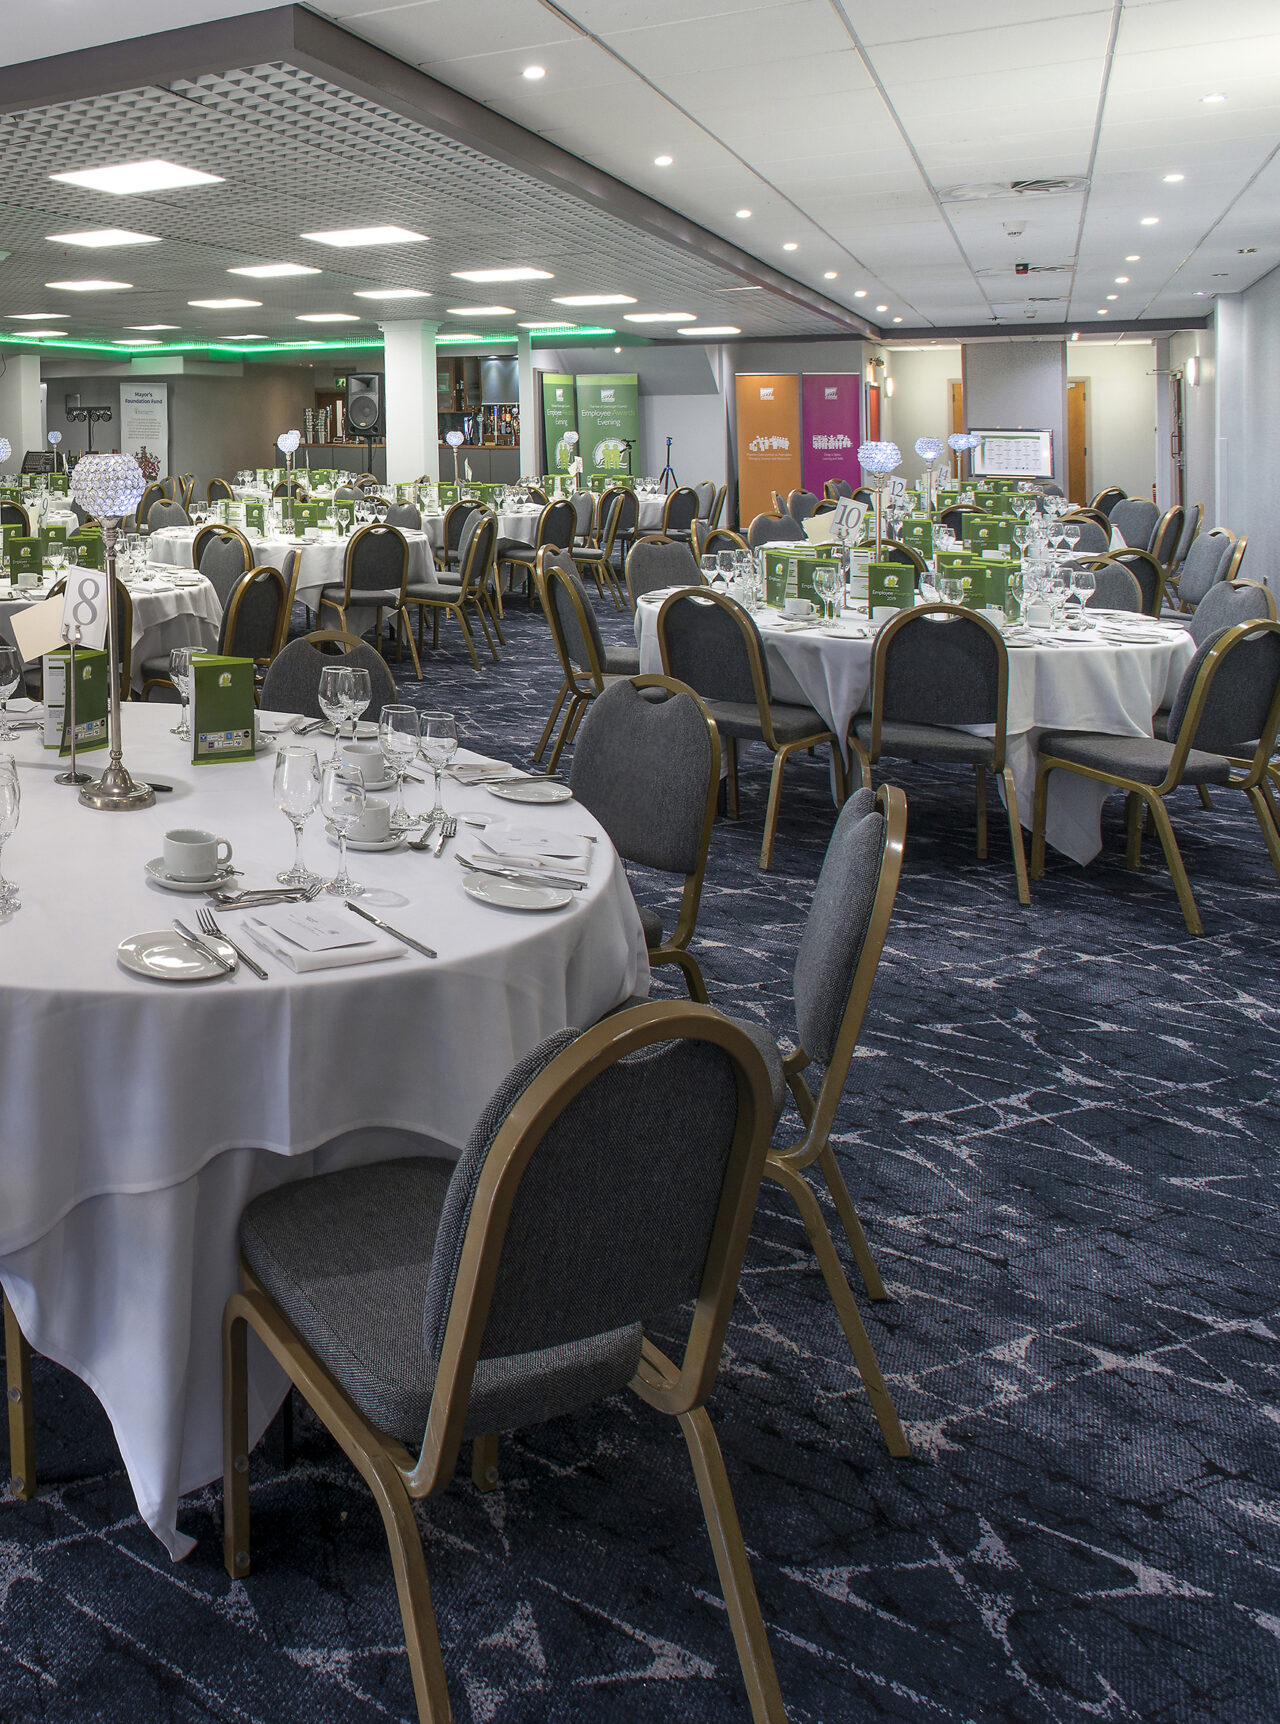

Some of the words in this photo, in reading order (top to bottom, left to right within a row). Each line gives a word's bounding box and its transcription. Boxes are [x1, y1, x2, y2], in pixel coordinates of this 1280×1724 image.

[597, 418, 621, 426] Evening
[890, 480, 905, 497] 12
[834, 503, 862, 529] 10
[72, 578, 100, 626] 8
